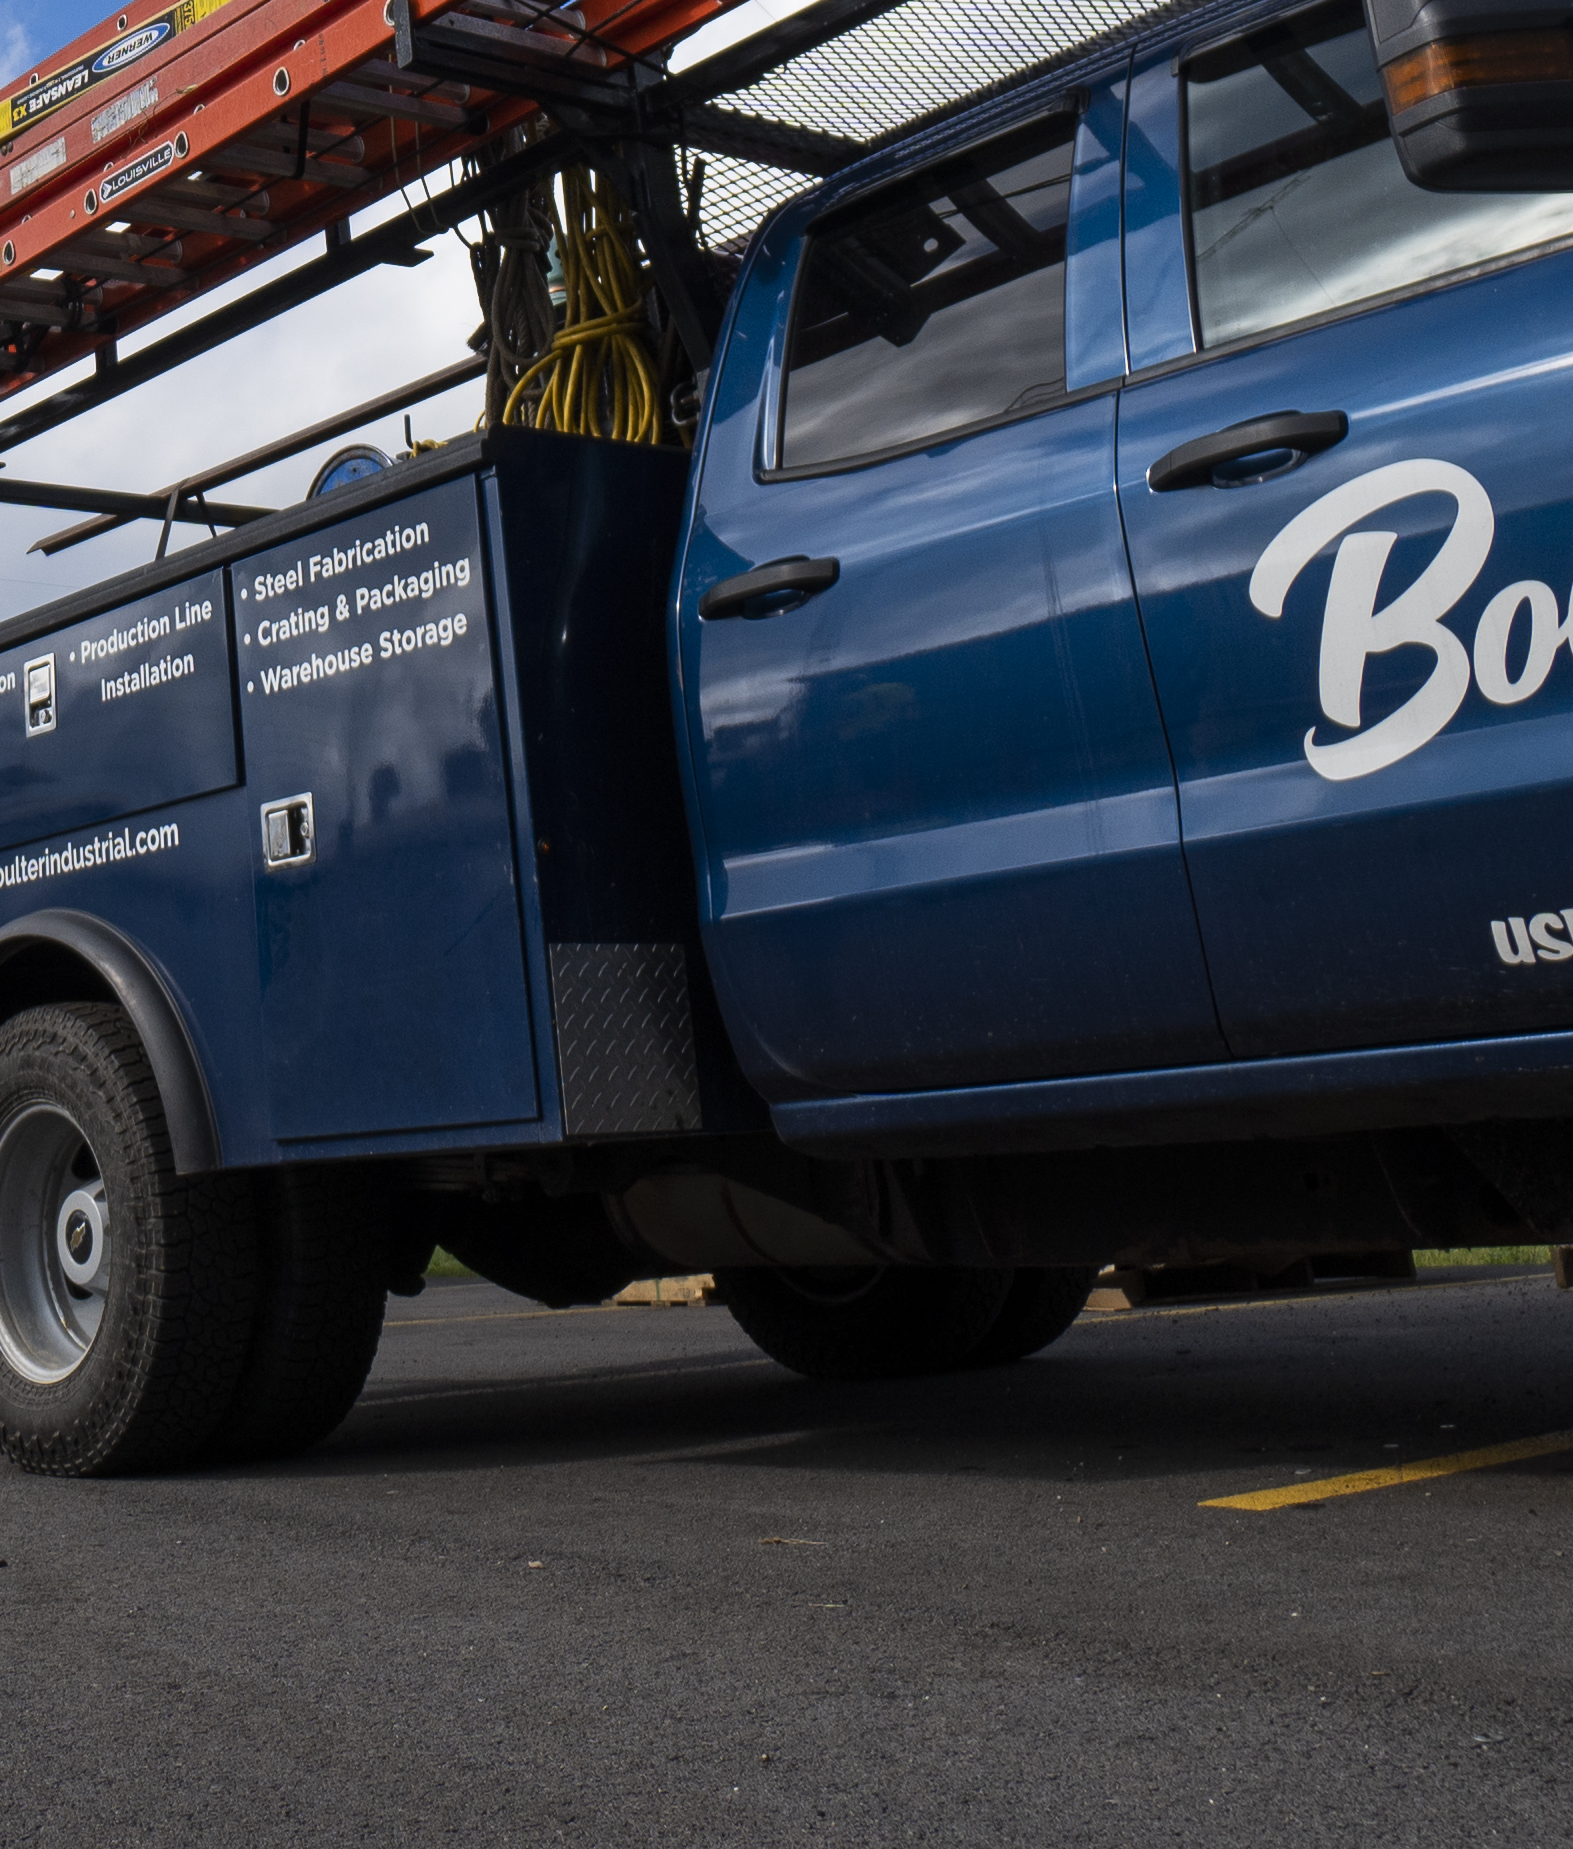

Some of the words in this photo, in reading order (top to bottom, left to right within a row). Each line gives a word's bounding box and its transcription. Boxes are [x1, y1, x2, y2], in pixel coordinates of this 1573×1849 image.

[106, 31, 153, 65] WERNER
[13, 105, 28, 121] X3
[29, 70, 89, 113] LEANSAFE
[112, 148, 171, 190] LOUISVILLE
[255, 561, 303, 601] Steel
[310, 521, 431, 585] Fabrication
[258, 606, 329, 646] Crating
[336, 595, 349, 620] &
[356, 559, 472, 615] Packaging
[81, 616, 171, 665] Production
[175, 601, 212, 630] Line
[261, 643, 372, 694] Warehouse
[380, 613, 467, 658] Storage
[102, 654, 194, 701] Installation
